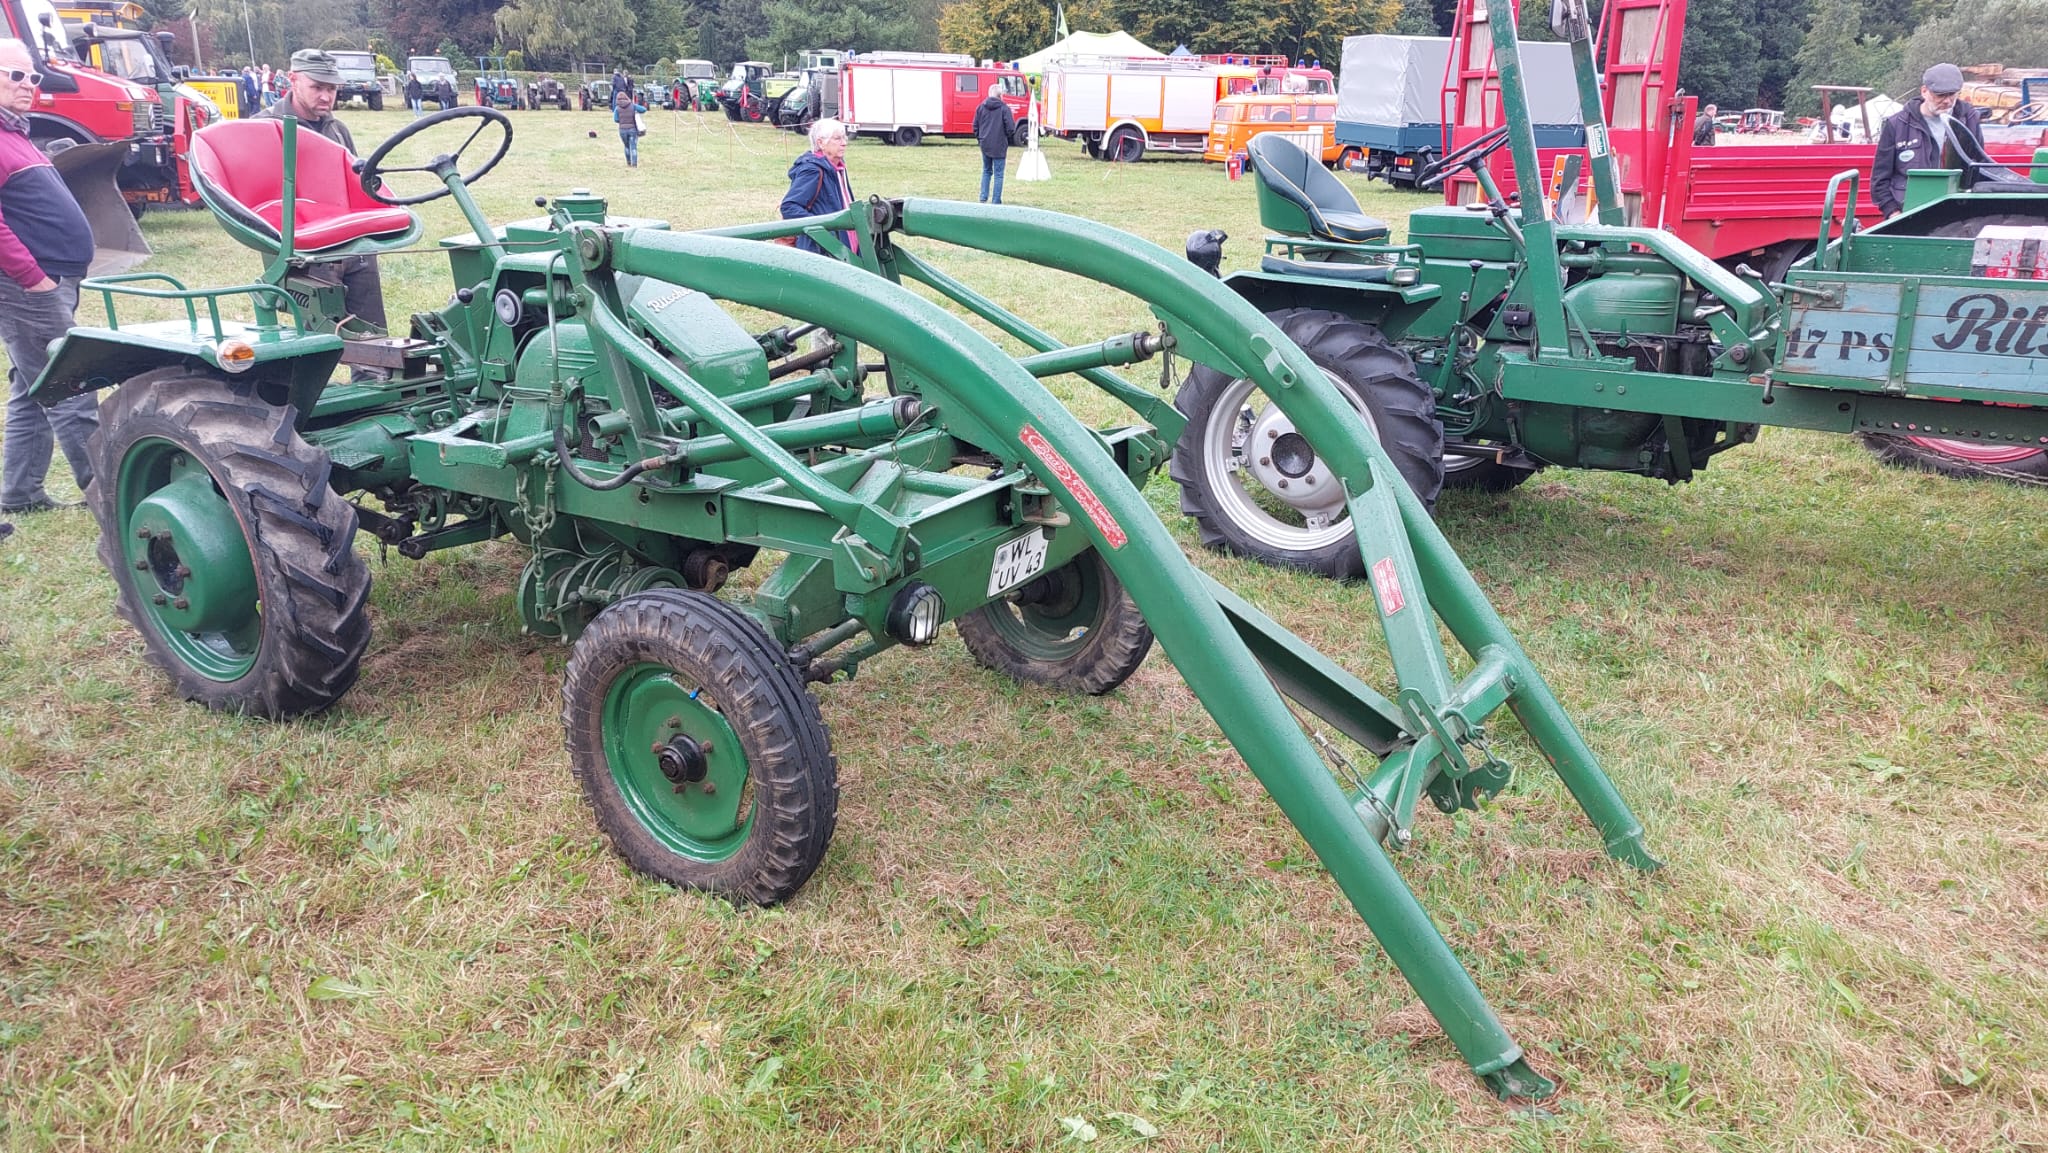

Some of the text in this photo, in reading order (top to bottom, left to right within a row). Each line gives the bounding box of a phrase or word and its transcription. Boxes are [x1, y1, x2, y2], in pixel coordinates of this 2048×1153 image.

[1932, 293, 2048, 358] Rit
[1786, 327, 1893, 363] 17 PS
[1010, 536, 1032, 563] WL
[998, 552, 1042, 589] UV 43
